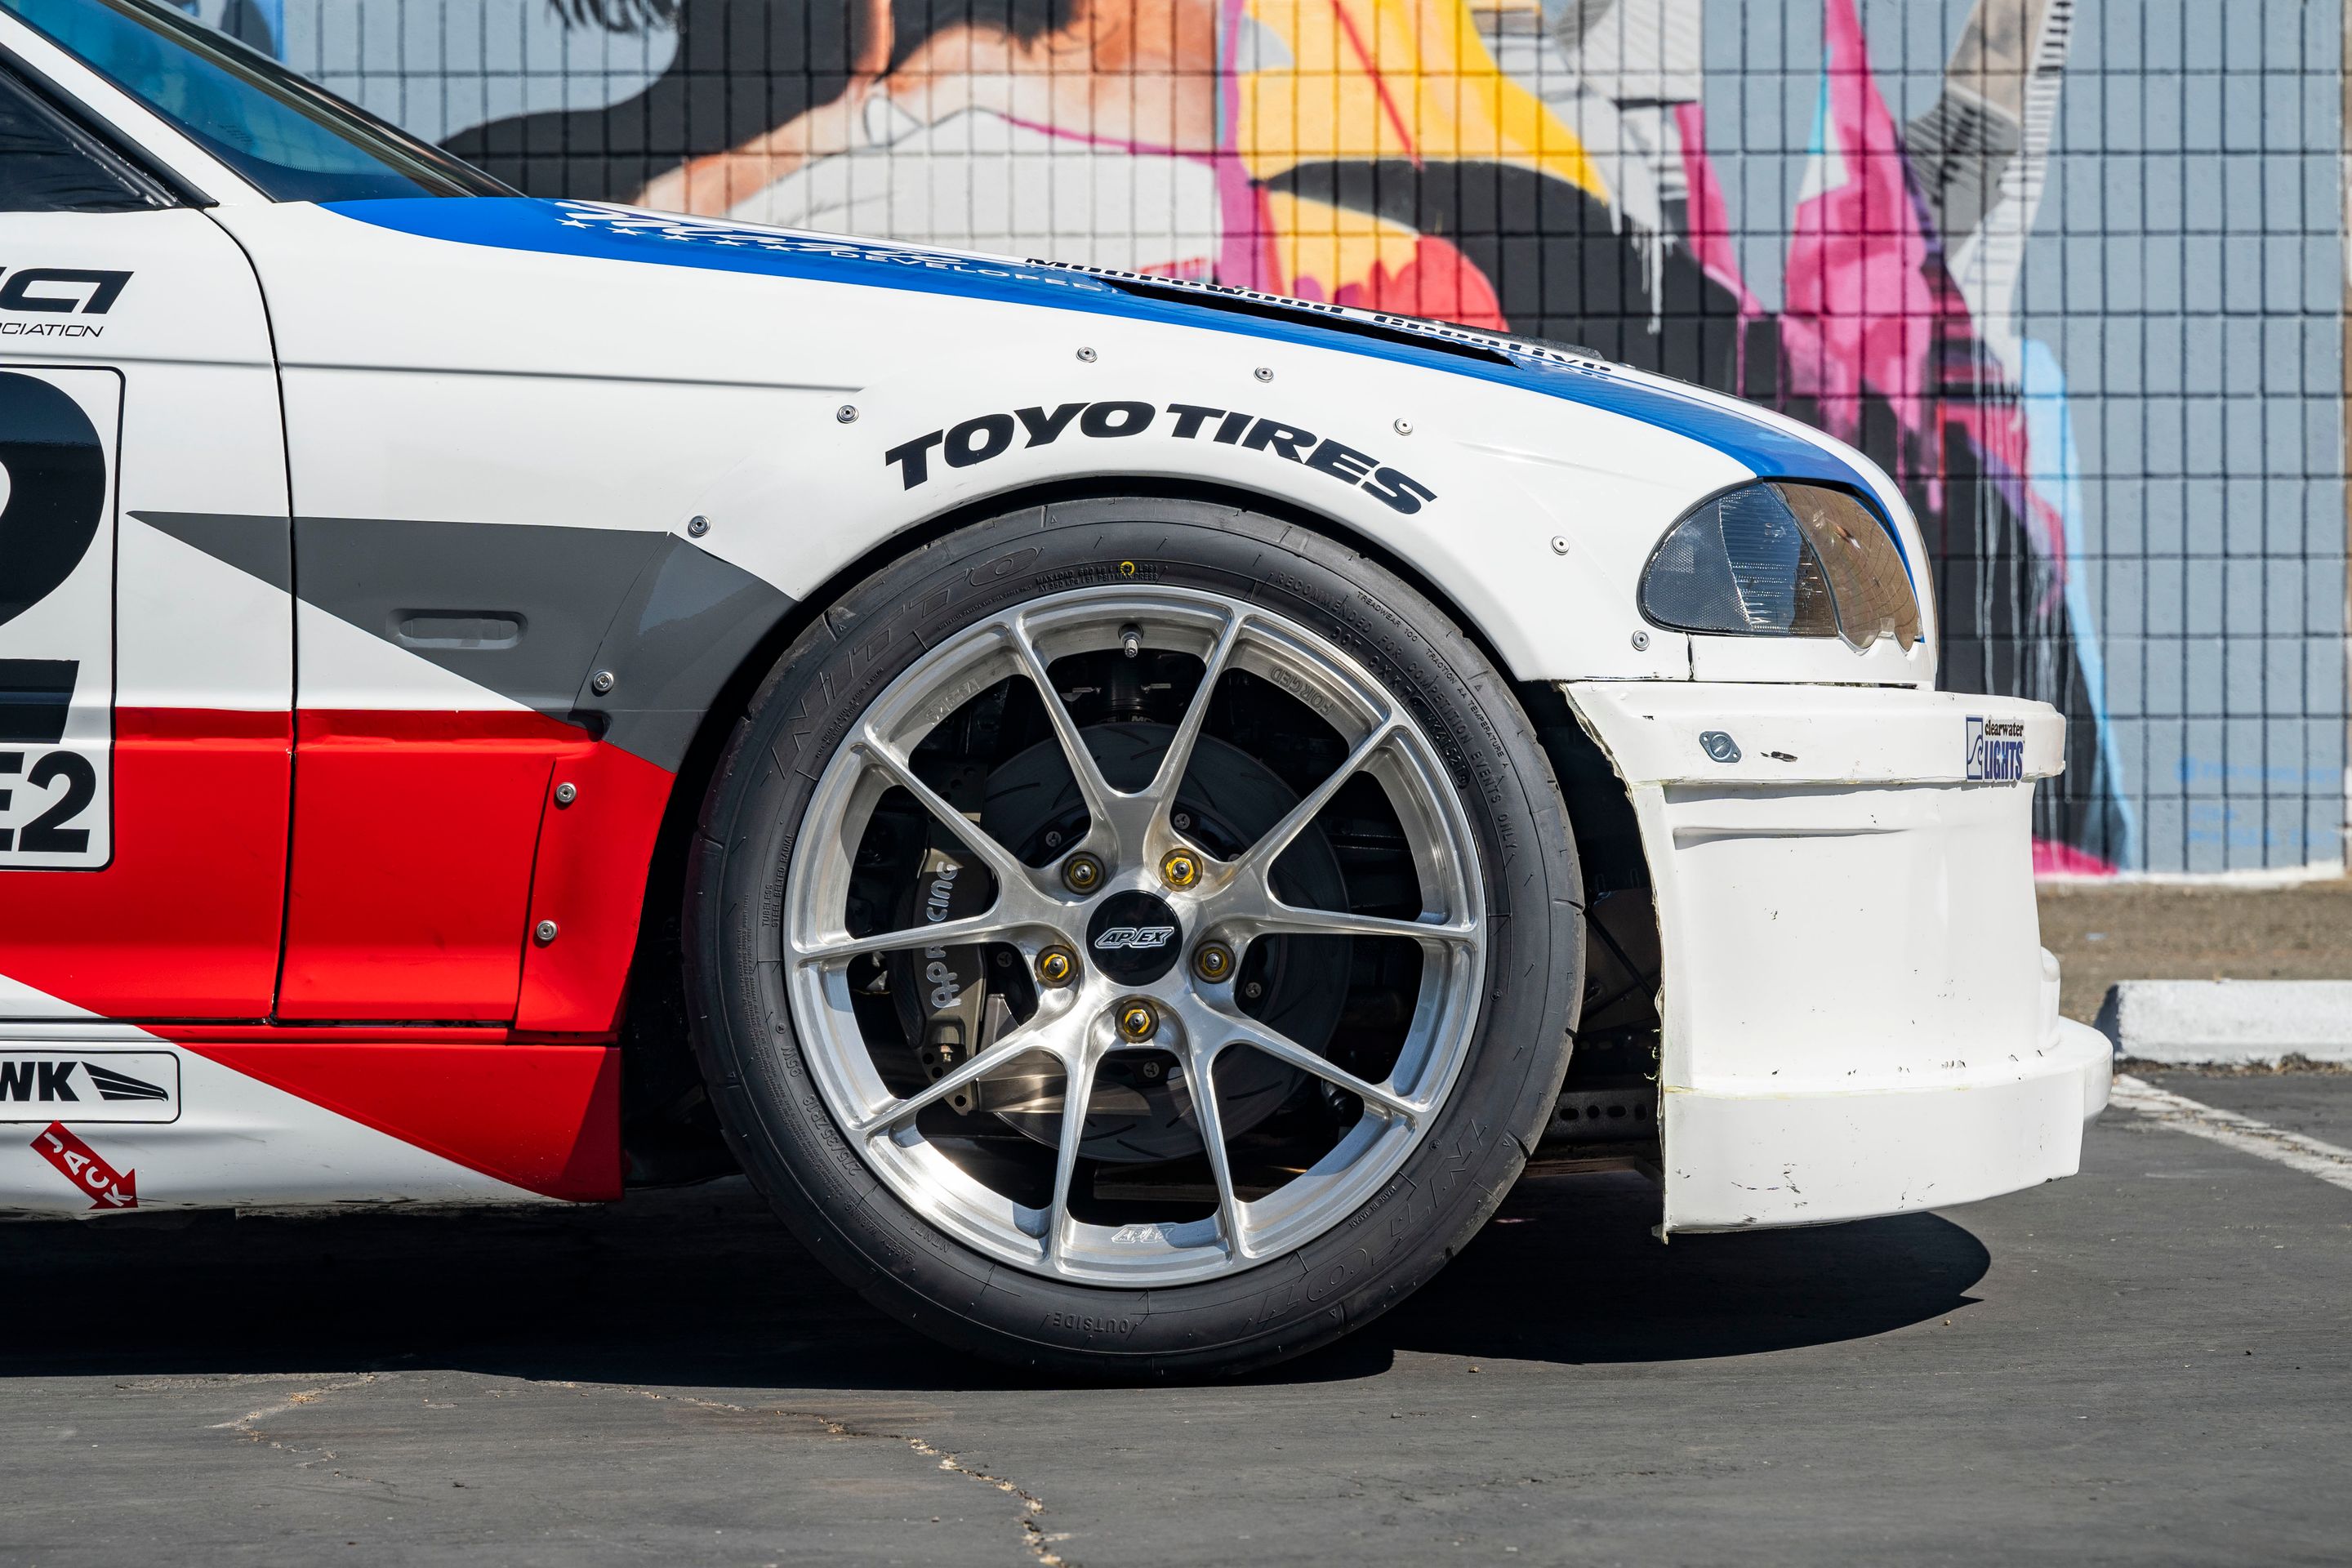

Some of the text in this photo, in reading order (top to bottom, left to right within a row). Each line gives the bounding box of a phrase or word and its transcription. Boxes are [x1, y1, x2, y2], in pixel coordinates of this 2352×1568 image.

[831, 250, 1102, 292] DEVELOPED
[885, 400, 1438, 515] TOYO TIRES
[1328, 624, 1363, 655] DOT
[1270, 666, 1335, 716] FORGED
[1354, 590, 1511, 770] TREADWEAR 100 TRACTION AA TEMPERATURE A
[1273, 570, 1518, 852] RECOMMENDED FOR COMPETITION EVENTS ONLY
[1984, 719, 2025, 737] clearwater
[1984, 740, 2024, 781] LIGHTS
[769, 831, 795, 929] STEEL BELTED RADIAL
[760, 881, 774, 928] TUBELESS
[1098, 929, 1170, 946] APEX
[778, 1041, 805, 1080] 95W
[800, 1093, 831, 1131] ZR18
[43, 1132, 133, 1207] JACK
[818, 1125, 864, 1179] 275/35
[1050, 1309, 1129, 1334] OUTSIDE
